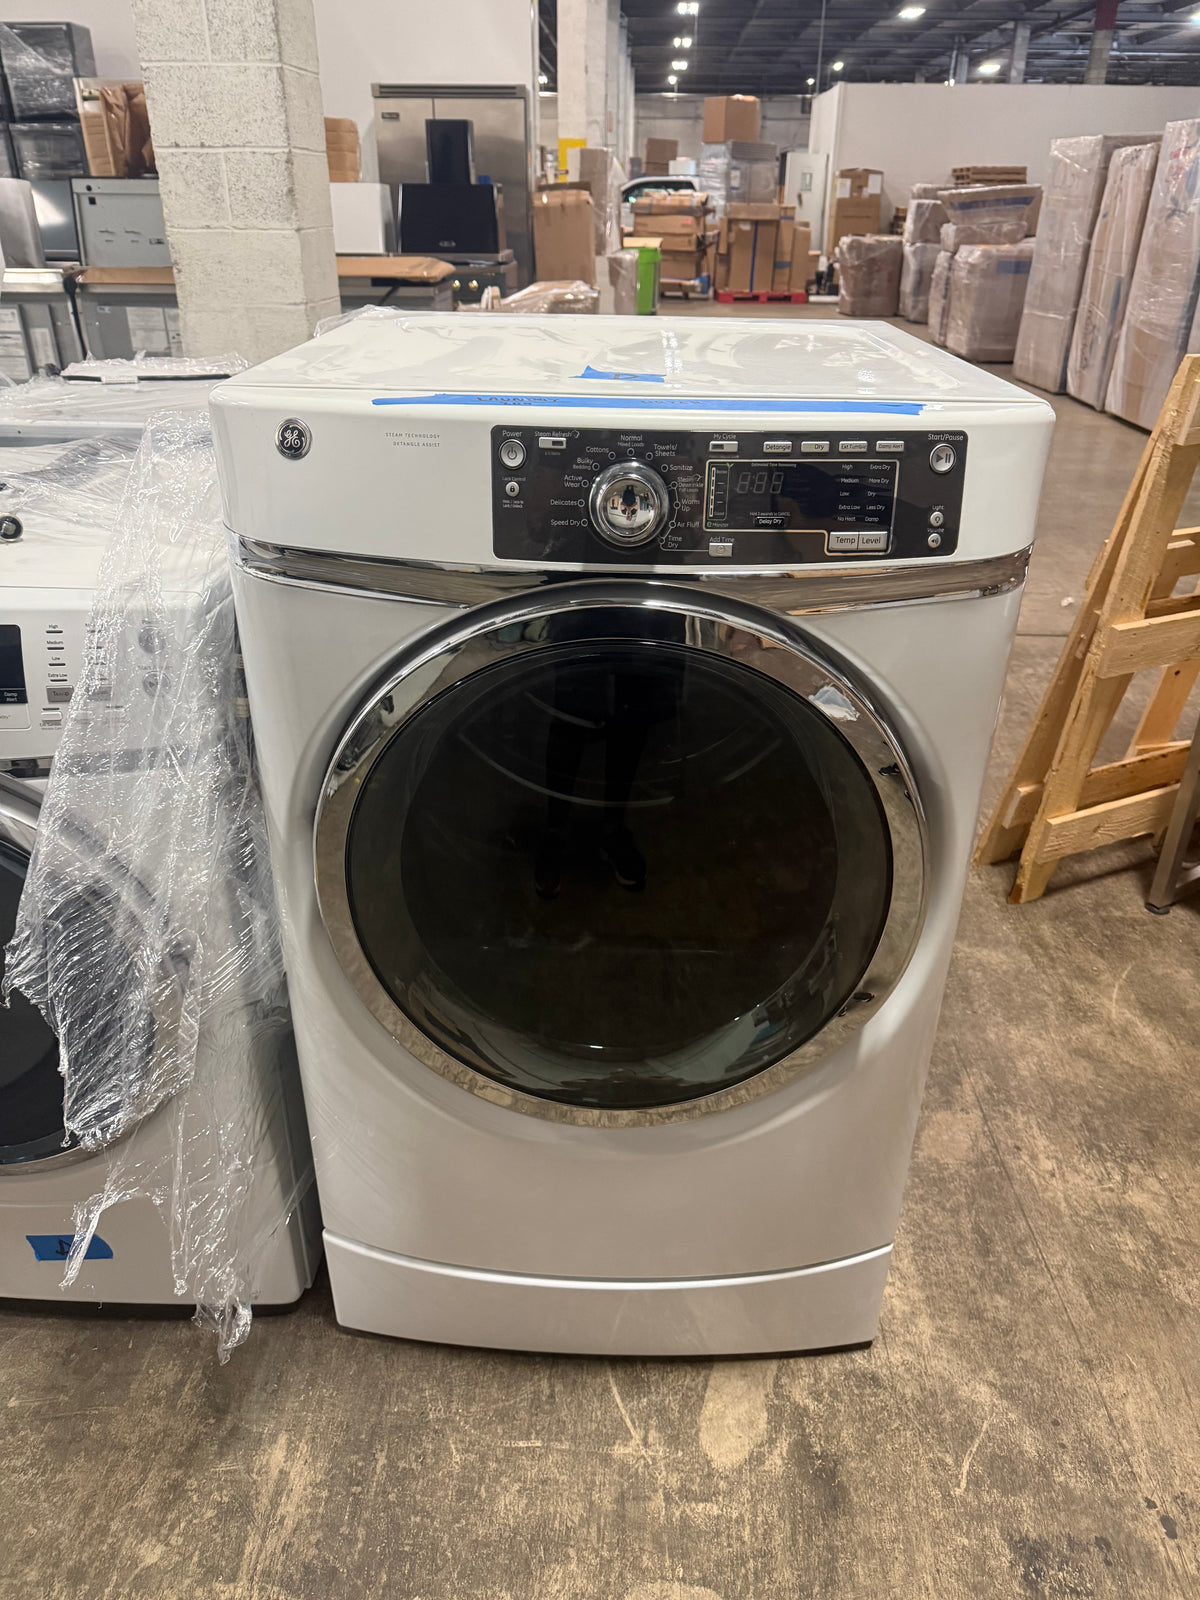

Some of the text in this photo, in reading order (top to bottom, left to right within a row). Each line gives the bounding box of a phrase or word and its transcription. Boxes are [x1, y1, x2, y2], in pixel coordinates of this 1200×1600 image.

[713, 432, 722, 440] My
[927, 433, 964, 441] Start/Pause
[653, 443, 678, 451] Towels/
[765, 443, 791, 451] Detangle
[814, 443, 824, 451] Dry
[576, 457, 593, 465] Bulky
[550, 519, 581, 527] Speed Dry
[835, 536, 856, 545] Temp
[861, 536, 881, 545] Level
[667, 541, 679, 549] Dry
